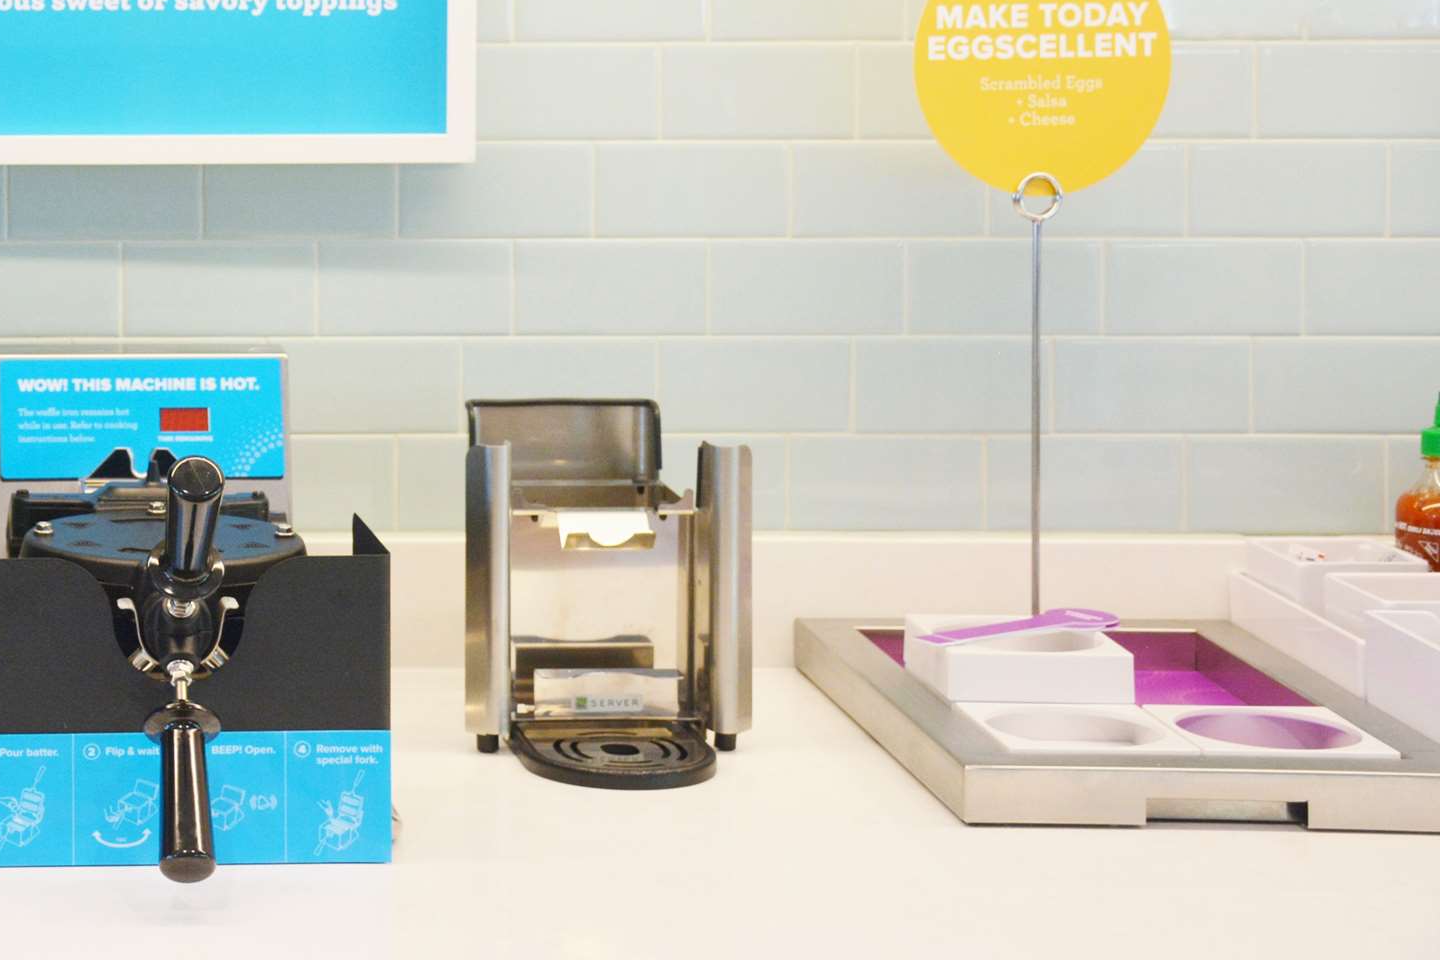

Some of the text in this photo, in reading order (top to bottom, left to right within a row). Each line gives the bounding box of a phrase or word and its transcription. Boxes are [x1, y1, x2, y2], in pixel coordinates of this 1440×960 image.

[935, 1, 1149, 30] MAKE TODAY
[927, 32, 1158, 61] EGGSCELLENT
[979, 73, 1104, 93] Scrambled Eggs
[1027, 93, 1067, 109] Salsa
[1020, 111, 1076, 127] Cheese
[17, 377, 260, 392] WOW! THIS MACHINE IS HOT.
[591, 698, 640, 708] SERVER
[0, 747, 23, 757] Pour
[26, 747, 59, 758] batter.
[105, 746, 123, 759] Flip
[127, 746, 136, 757] &
[211, 745, 276, 756] BEEP! Open.
[316, 744, 358, 754] Remove
[360, 743, 383, 753] with
[316, 755, 379, 768] special fork.
